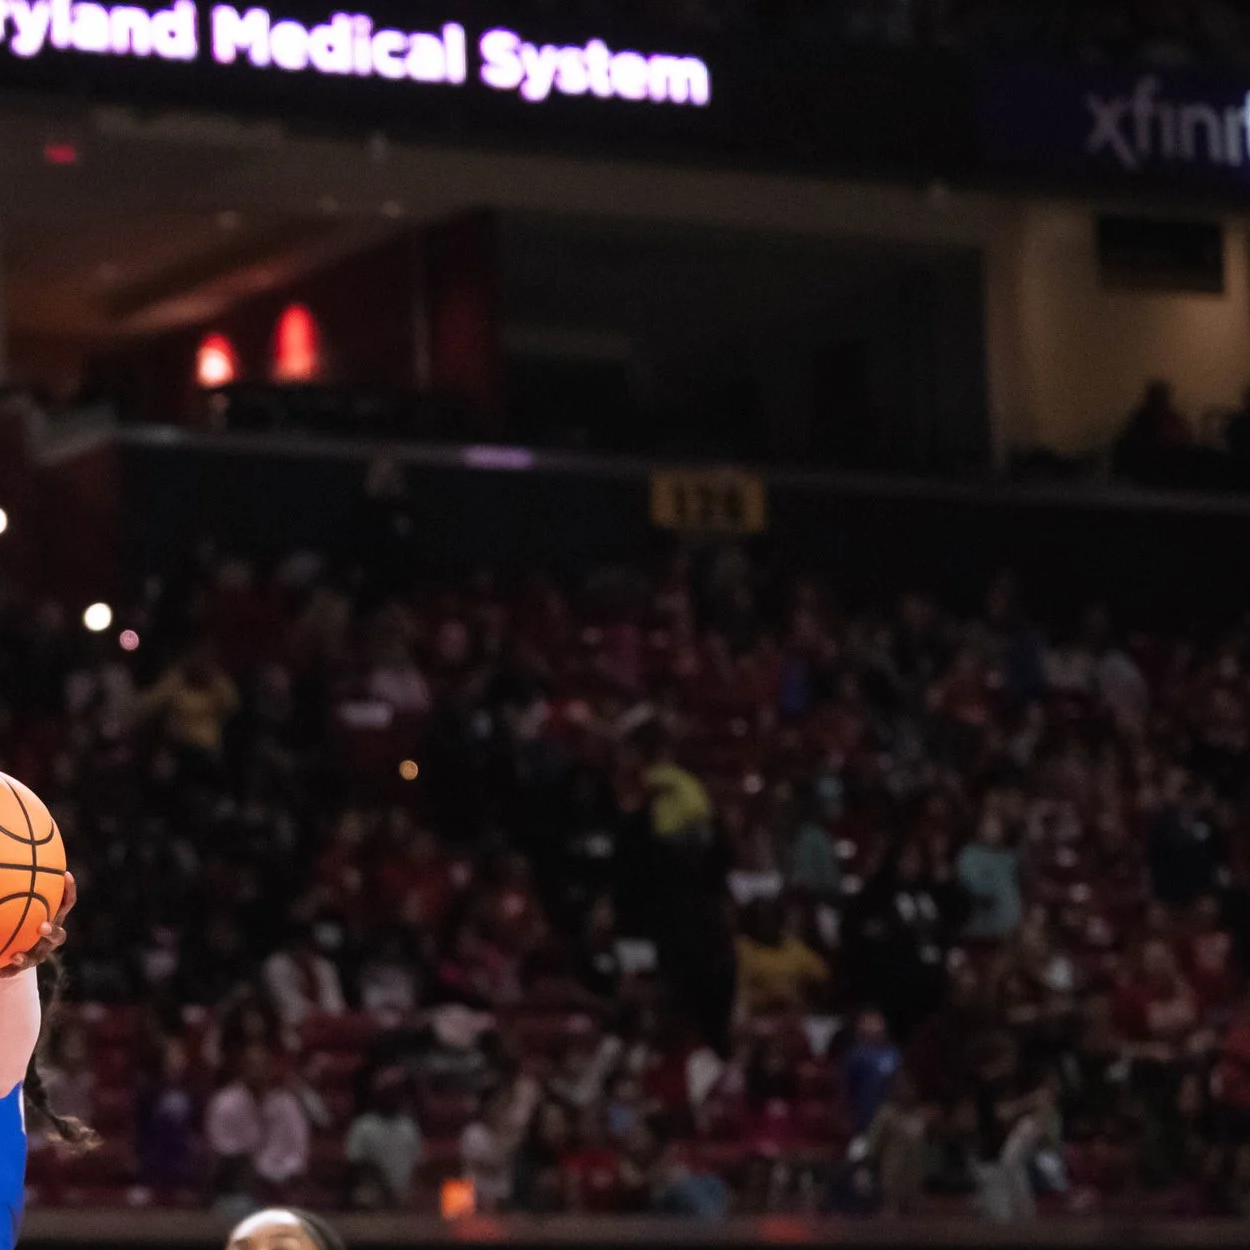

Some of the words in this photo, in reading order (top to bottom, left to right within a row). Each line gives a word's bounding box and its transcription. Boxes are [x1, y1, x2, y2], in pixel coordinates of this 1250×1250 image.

[211, 4, 467, 84] Medical
[480, 26, 710, 105] System
[1085, 75, 1250, 172] xfini
